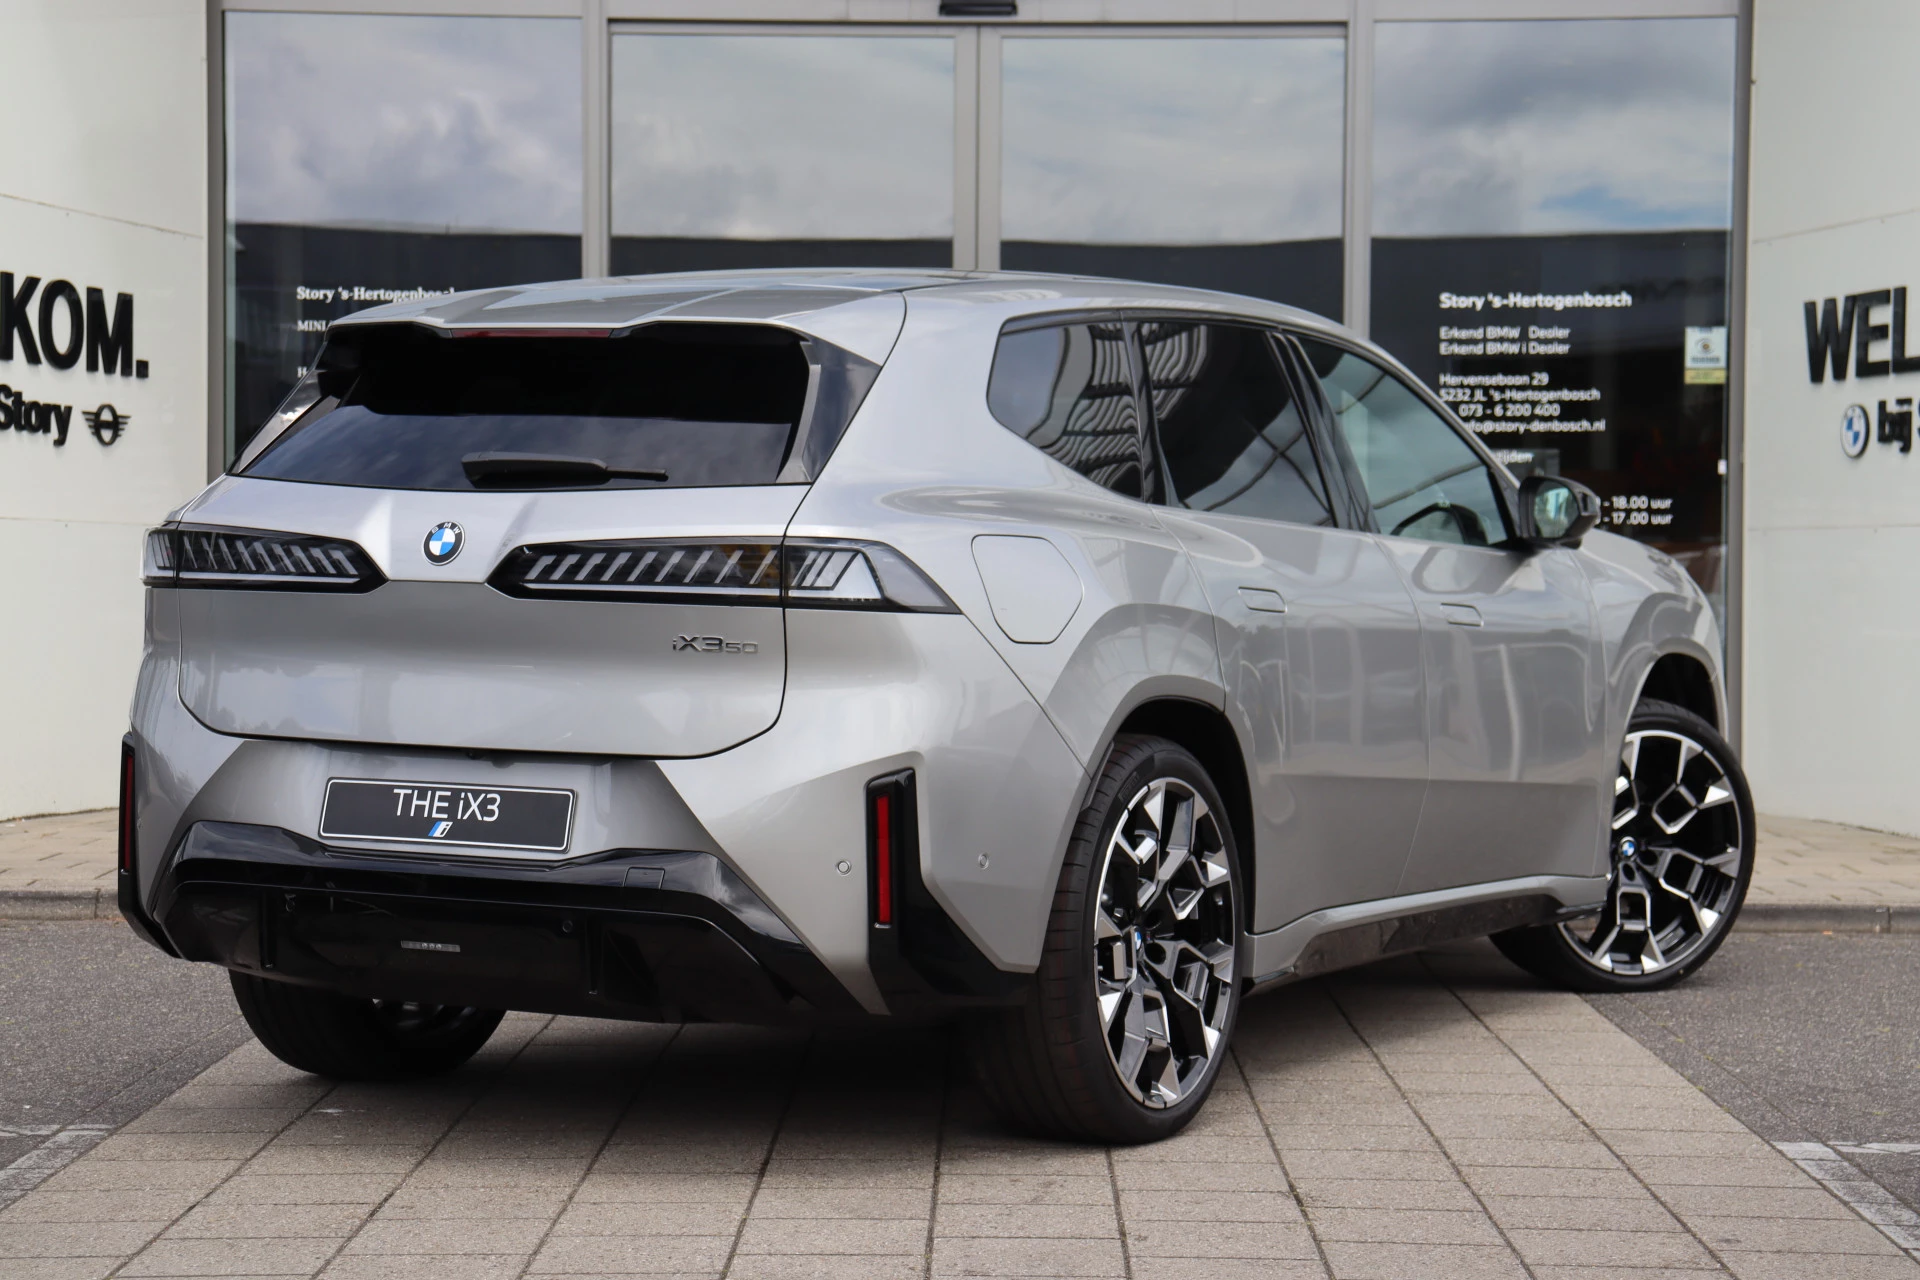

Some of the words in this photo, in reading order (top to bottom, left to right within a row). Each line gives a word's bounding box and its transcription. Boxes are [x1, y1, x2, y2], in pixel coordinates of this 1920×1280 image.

[297, 286, 336, 304] Story
[1439, 291, 1486, 312] Story
[0, 270, 149, 379] KOM.
[1439, 326, 1485, 340] Erkend
[1486, 326, 1521, 340] BMW
[1528, 326, 1571, 340] Dealer
[1804, 286, 1920, 383] WEL
[1439, 341, 1485, 355] Erkend
[1486, 341, 1521, 355] BMW
[1521, 341, 1527, 354] i
[1528, 341, 1571, 355] Dealer
[1439, 372, 1530, 386] Hervensebaan
[1531, 372, 1549, 386] 29
[1439, 388, 1472, 401] 5232
[1473, 388, 1488, 402] JL
[0, 383, 73, 447] Story
[1458, 403, 1484, 417] 073
[1493, 403, 1504, 417] 6
[1505, 403, 1532, 417] 200
[1533, 403, 1561, 417] 400
[1464, 419, 1606, 435] nfo@story-denbosch.nl
[1611, 495, 1649, 509] 18.00
[1650, 498, 1673, 509] uur
[1650, 514, 1673, 525] uur
[431, 522, 461, 534] BMW
[393, 788, 452, 819] THE
[457, 792, 501, 822] iX3
